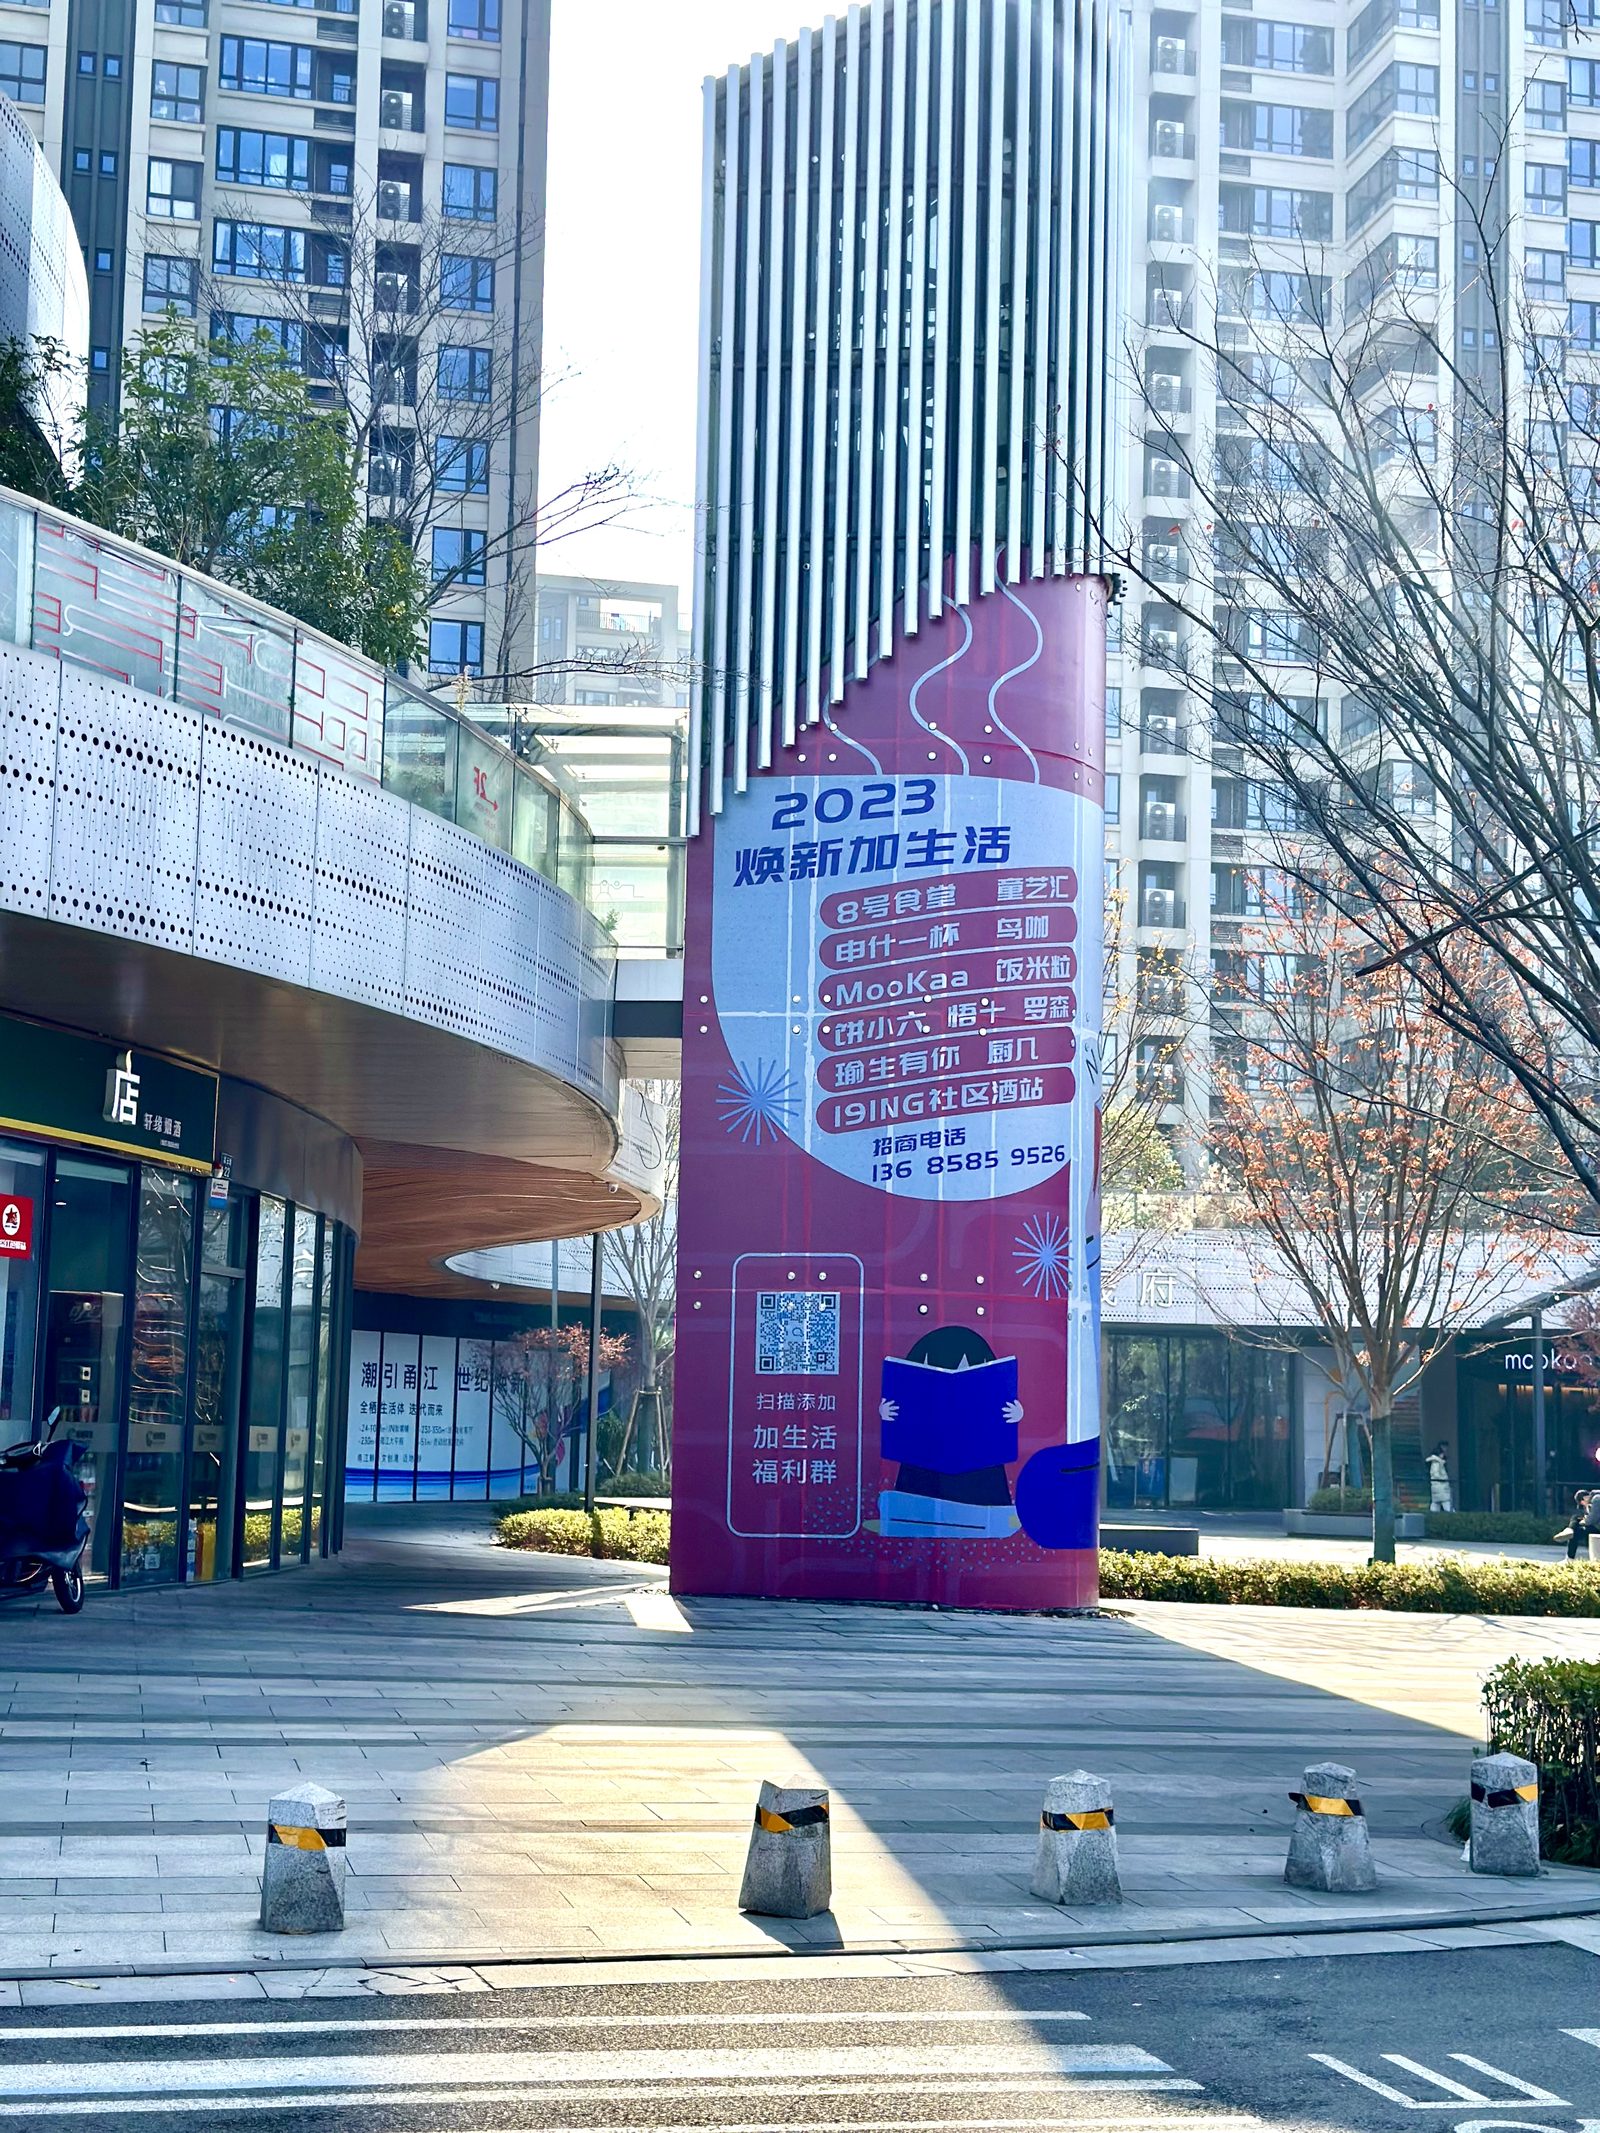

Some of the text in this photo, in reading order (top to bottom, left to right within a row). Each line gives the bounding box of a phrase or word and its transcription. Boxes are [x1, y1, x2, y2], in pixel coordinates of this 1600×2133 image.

[772, 778, 936, 830] 2023
[733, 826, 1011, 887] 焕新加生活
[837, 875, 1069, 924] 8号食堂 童艺汇
[836, 915, 1049, 962] 申什一杯 鸟咖
[836, 954, 1071, 1006] MooKaa 饭米粒
[834, 1011, 927, 1046] 饼小六
[1023, 995, 1070, 1021] 罗森
[110, 1050, 141, 1126] 店
[872, 1127, 966, 1157] 招商电话
[872, 1145, 1065, 1182] 136 8585 9526
[361, 1362, 438, 1390] 潮引甬江
[756, 1392, 836, 1411] 扫描添加
[753, 1424, 838, 1450] 加生活
[752, 1459, 837, 1485] 福利群
